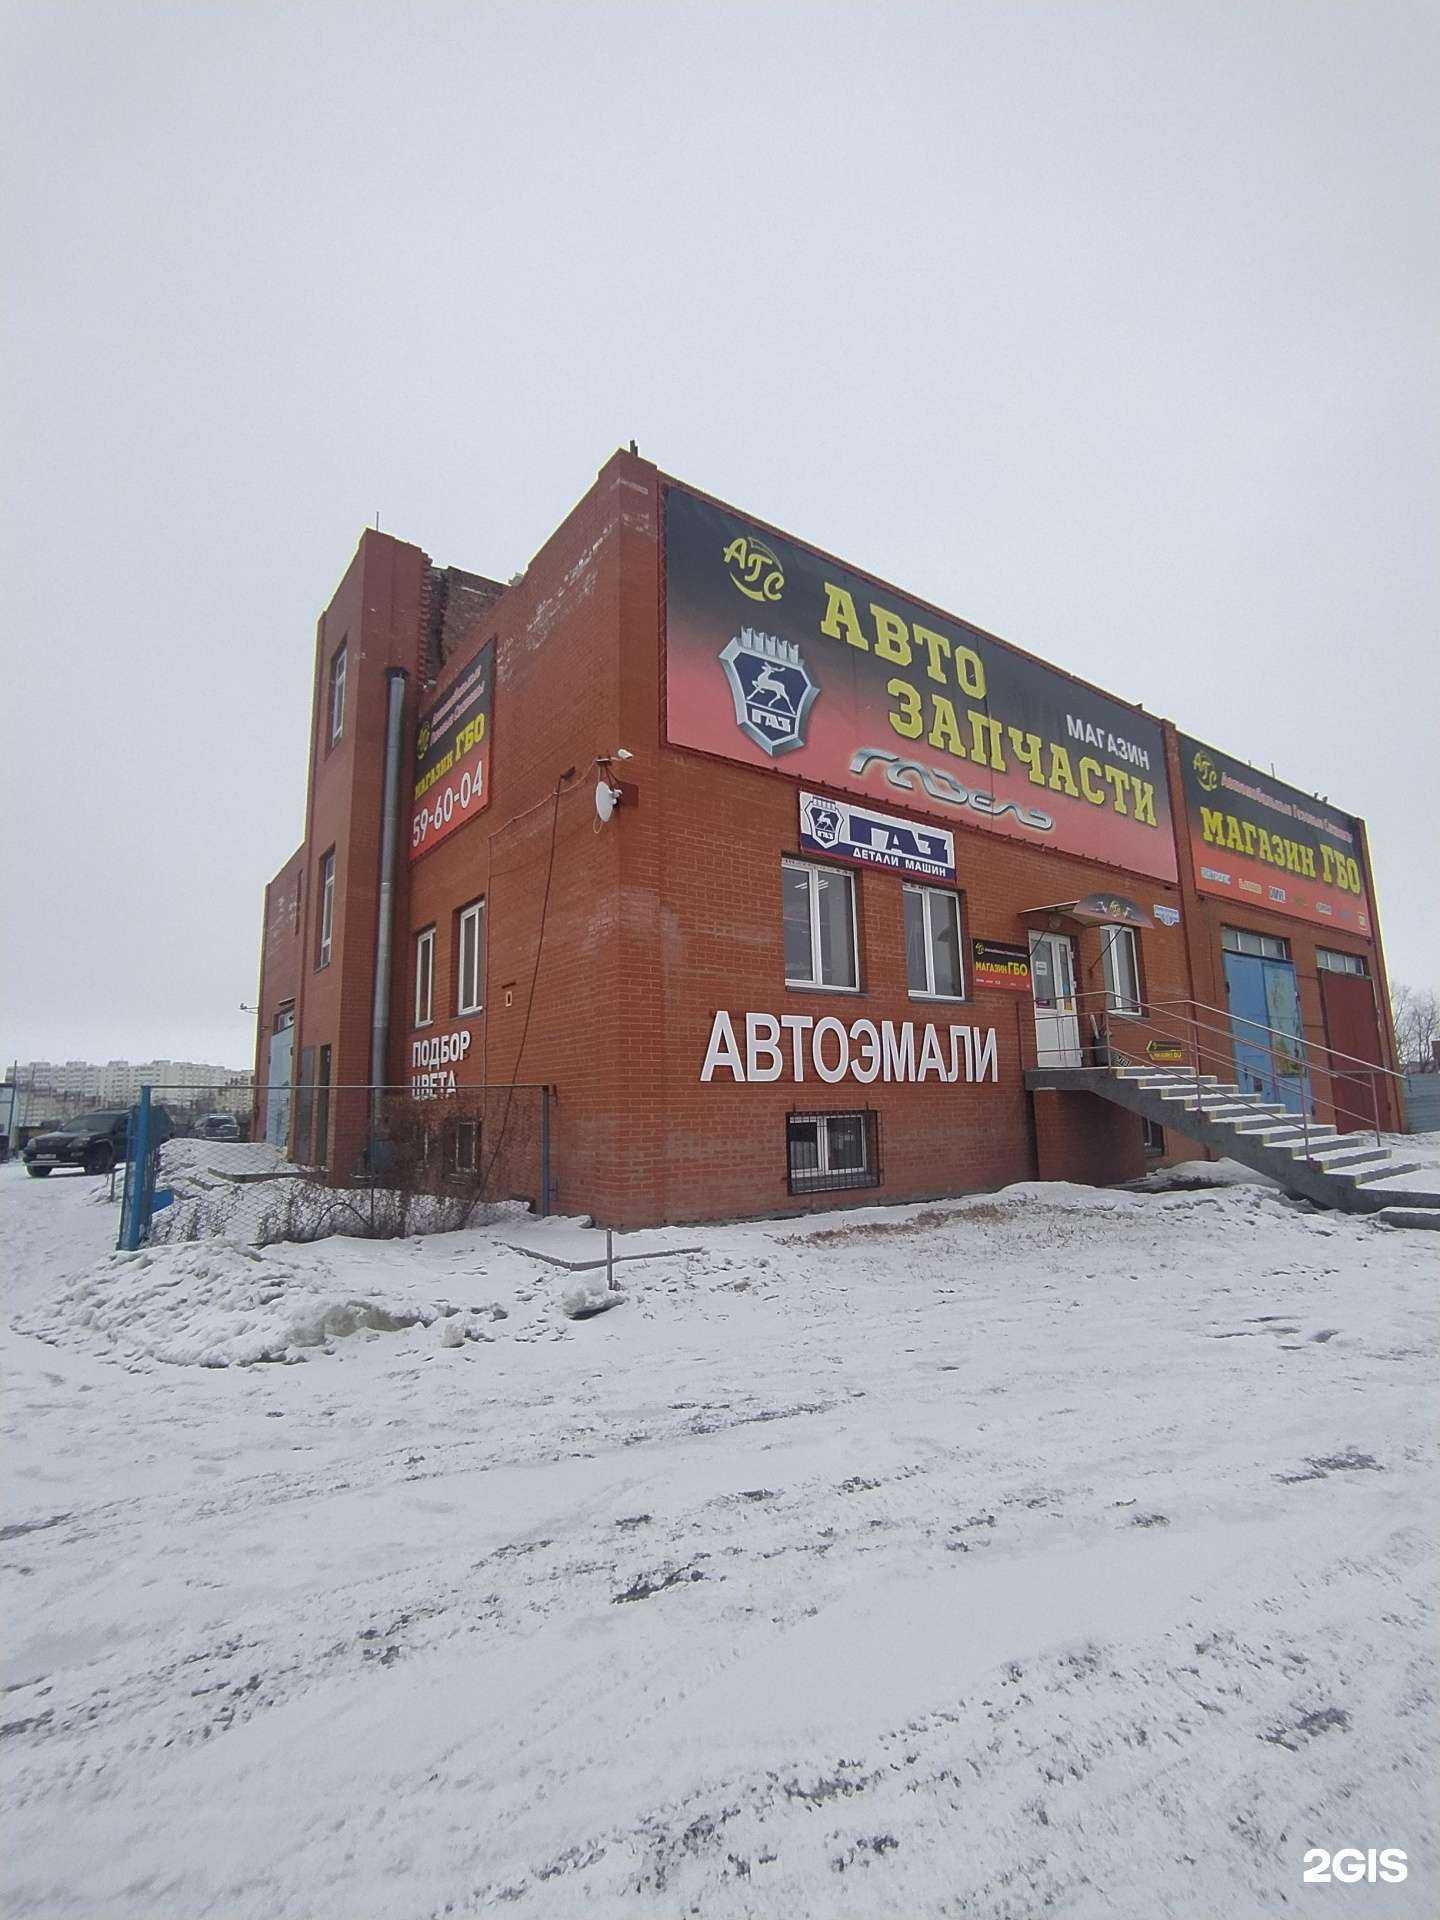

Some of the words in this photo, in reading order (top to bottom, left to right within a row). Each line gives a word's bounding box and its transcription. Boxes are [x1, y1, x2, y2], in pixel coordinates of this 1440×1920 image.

[820, 582, 987, 700] АВТО
[454, 712, 485, 763] ГБО
[887, 678, 1159, 827] ЗАПЧАСТИ
[1066, 714, 1151, 772] МАГАЗИН
[412, 760, 483, 848] 59-60-04
[850, 814, 949, 864] ГАЗ
[852, 847, 899, 866] ДЕТАЛИ
[905, 860, 947, 877] МАШИН
[1200, 806, 1316, 878] МАГАЗИН
[1319, 843, 1361, 894] ГБО
[1007, 961, 1028, 977] ГБО
[412, 1030, 471, 1071] ПОДБОР
[700, 1010, 999, 1084] АВТОЭМАЛИ
